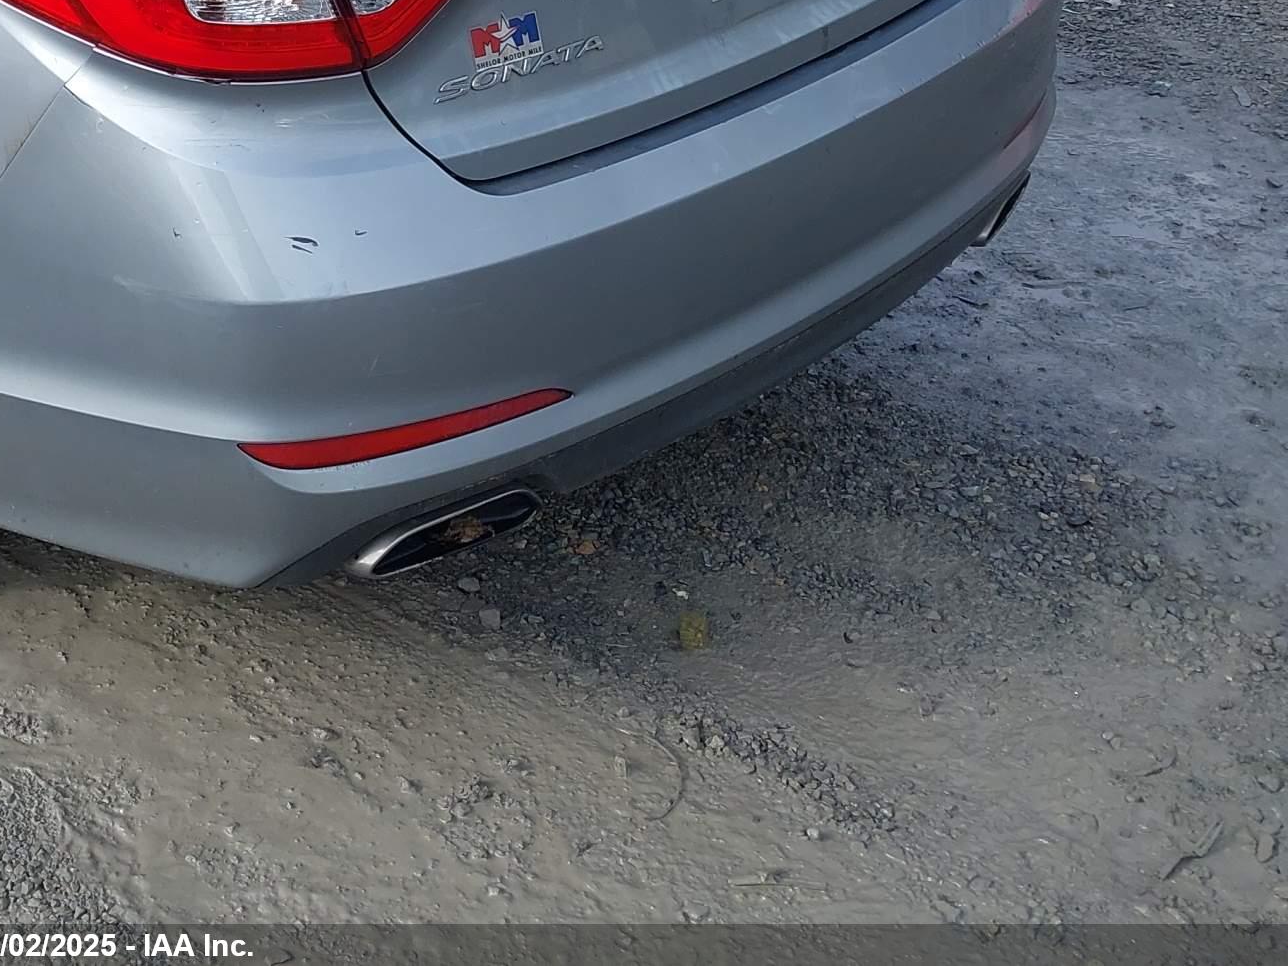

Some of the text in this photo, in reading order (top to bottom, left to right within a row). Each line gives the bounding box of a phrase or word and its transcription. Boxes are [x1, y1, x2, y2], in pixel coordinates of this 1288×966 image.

[433, 35, 604, 105] SONATA
[477, 46, 542, 70] SHELOR MOTOR MILE
